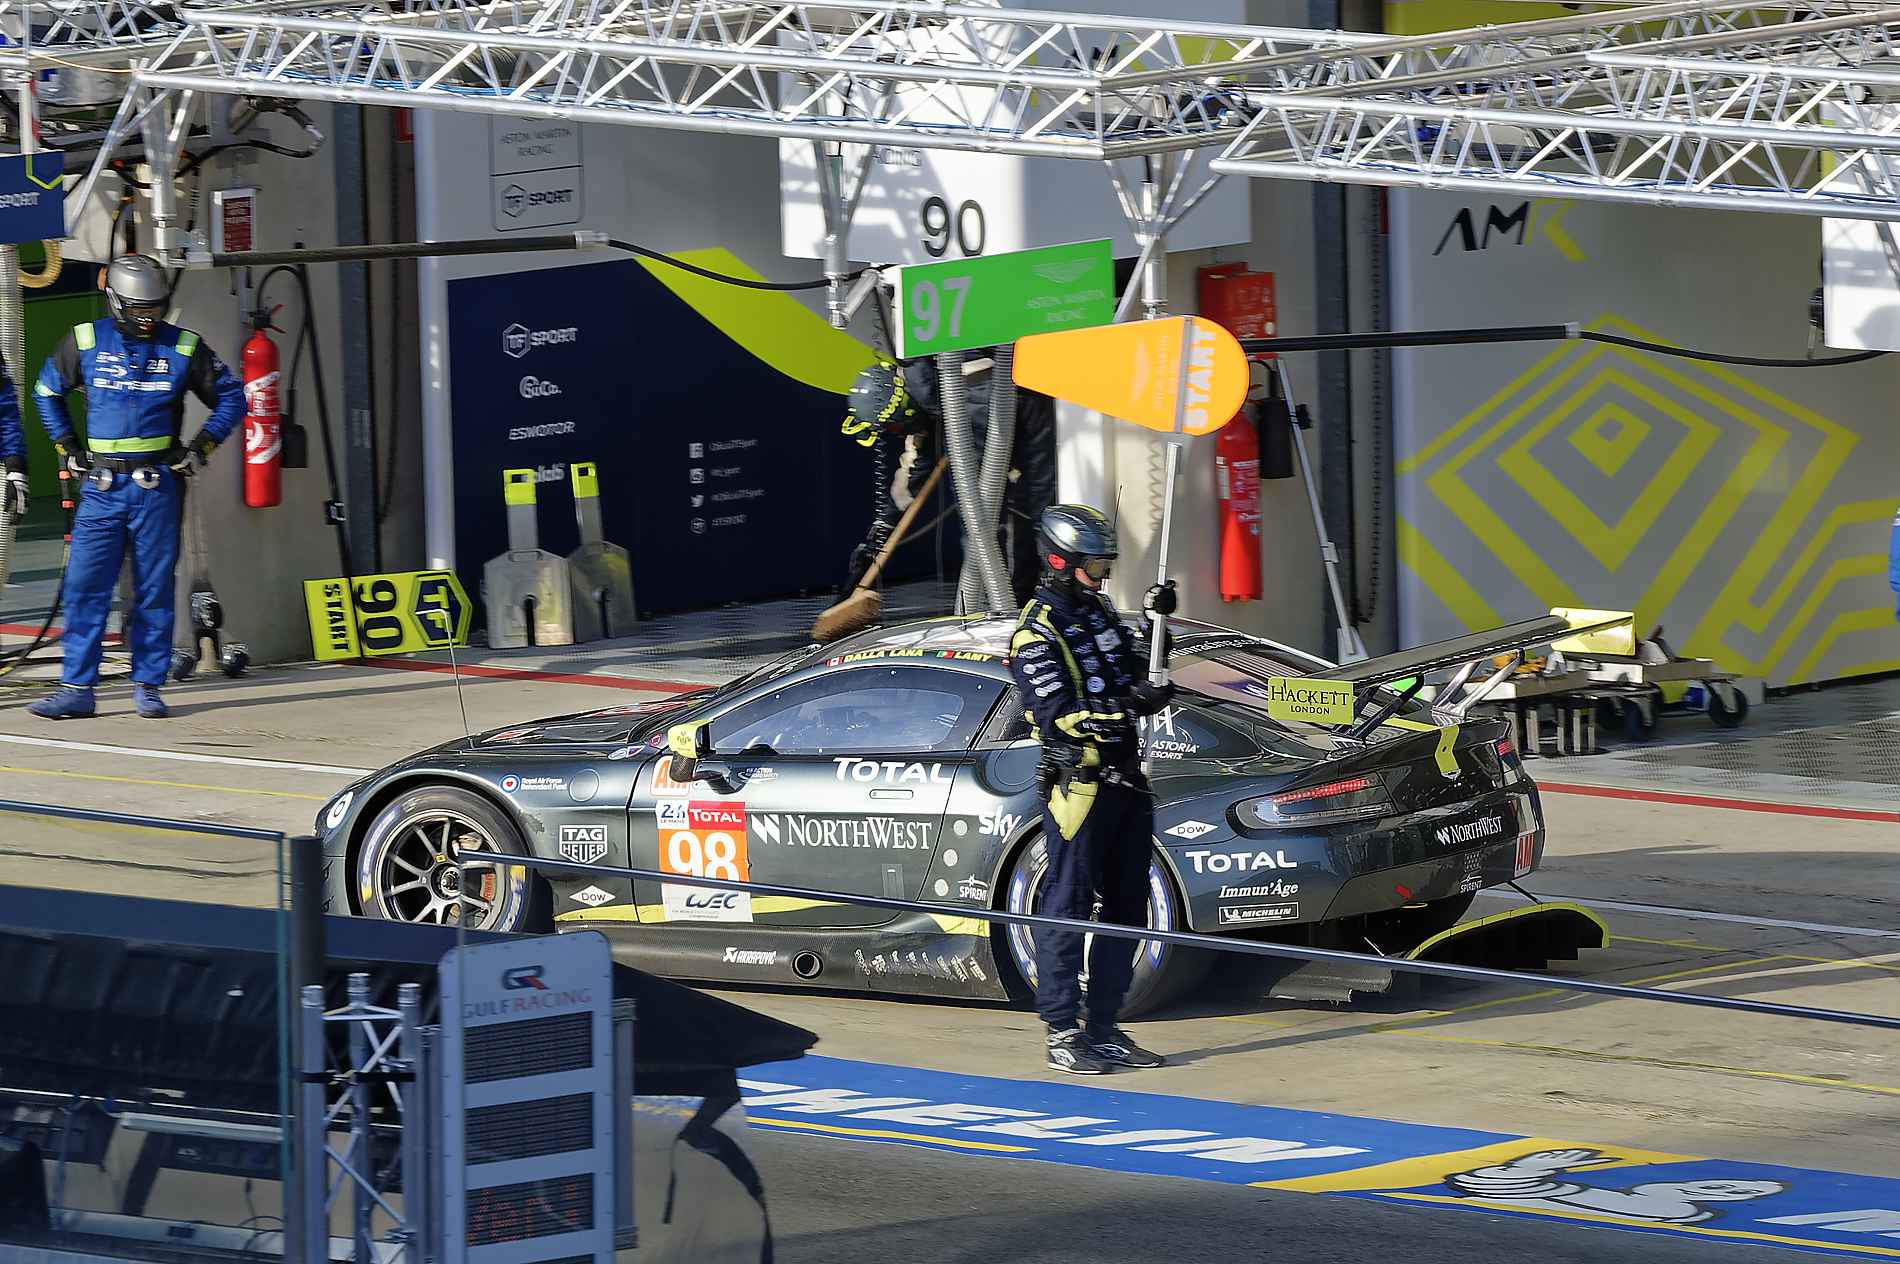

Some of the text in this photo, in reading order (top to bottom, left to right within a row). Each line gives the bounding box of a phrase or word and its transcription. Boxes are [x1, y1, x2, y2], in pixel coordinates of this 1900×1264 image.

[529, 189, 574, 206] SPORT
[922, 196, 986, 257] 90
[910, 276, 971, 342] 97
[531, 327, 578, 346] SPORT
[1183, 325, 1217, 430] START
[323, 583, 350, 650] START
[354, 579, 403, 650] 90
[843, 650, 885, 663] DALLA
[954, 651, 993, 662] LAMY
[1271, 685, 1350, 706] HACKETT
[1290, 705, 1330, 715] LONDON
[1150, 740, 1197, 754] ASTORIA
[833, 757, 952, 784] TOTAL
[689, 808, 742, 823] TOTAL
[978, 804, 1022, 844] sky
[563, 828, 603, 841] TAG
[563, 843, 603, 863] HEUER
[668, 831, 740, 882] 98
[1185, 850, 1298, 874] TOTAL
[1218, 879, 1299, 899] Immun'Âge
[1460, 880, 1483, 893] SPIRENT
[685, 893, 739, 909] WEC
[1241, 908, 1292, 918] MICHELIN
